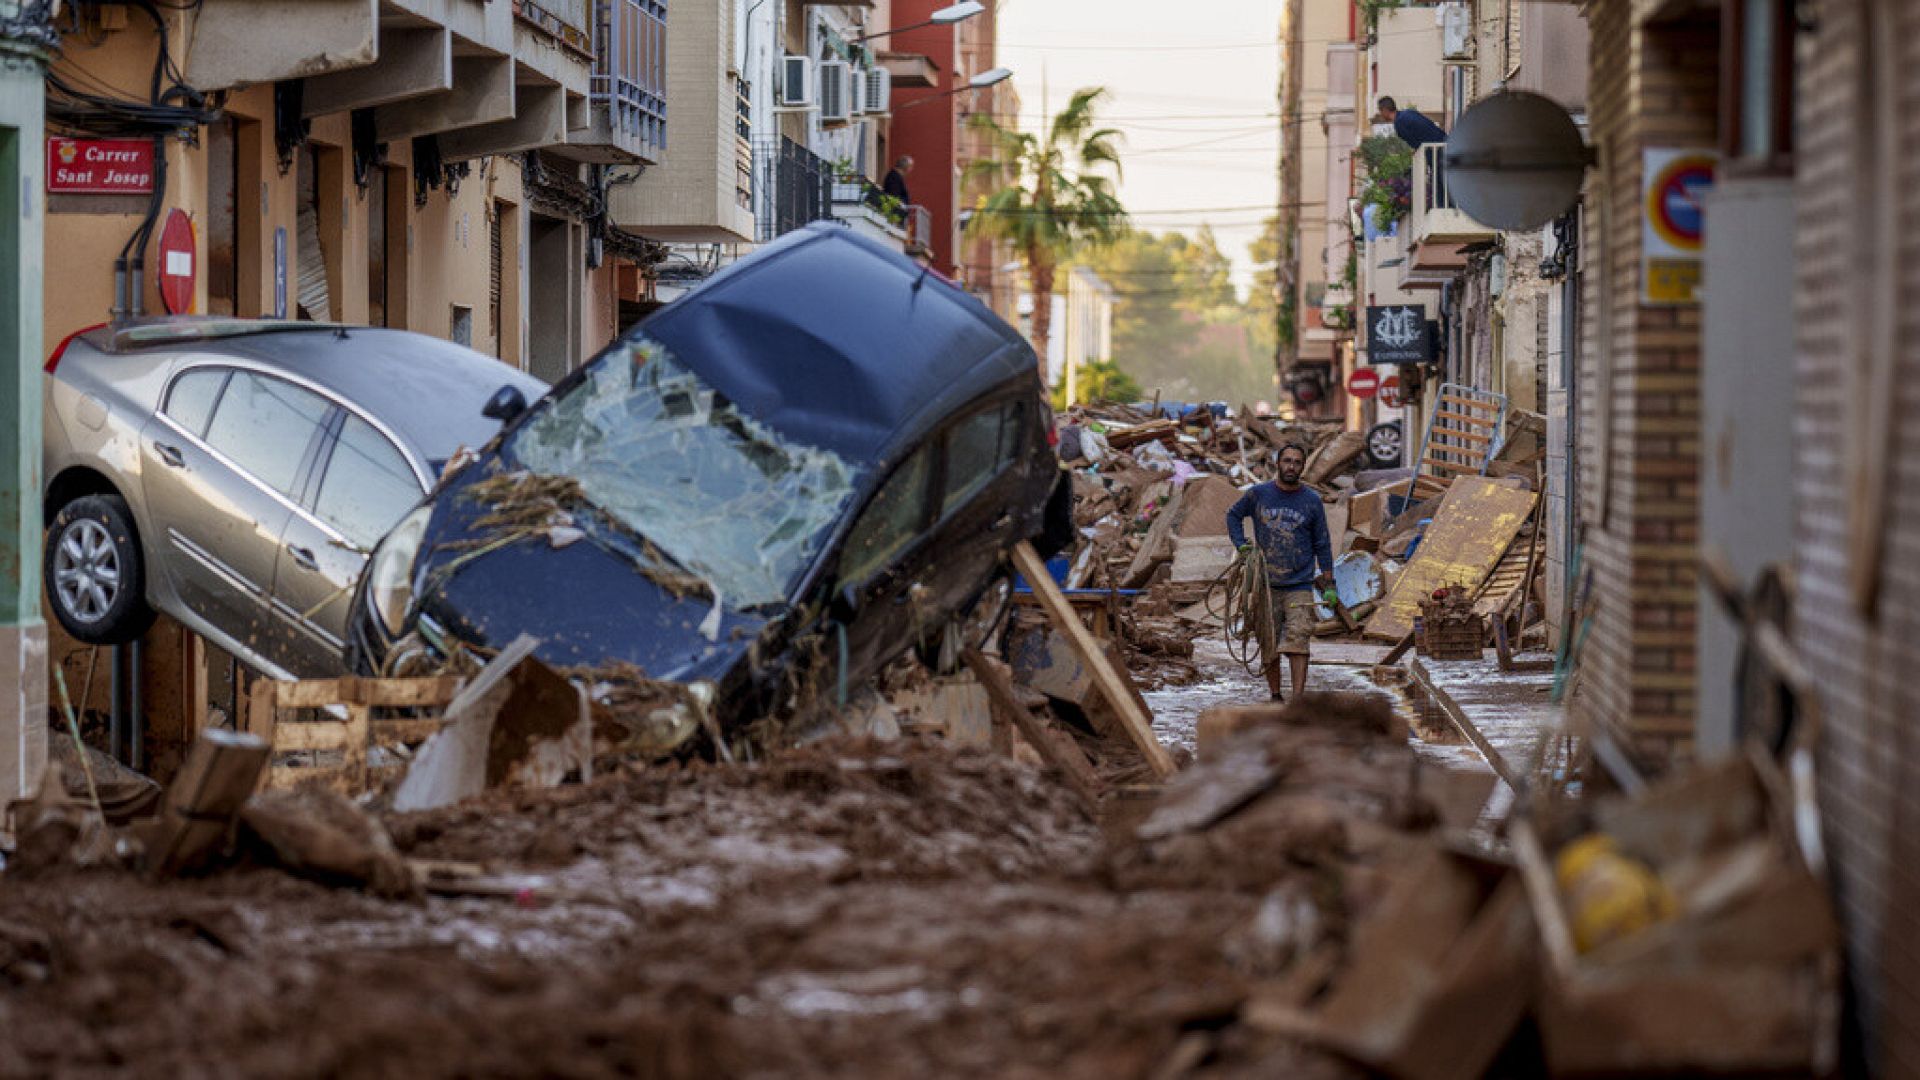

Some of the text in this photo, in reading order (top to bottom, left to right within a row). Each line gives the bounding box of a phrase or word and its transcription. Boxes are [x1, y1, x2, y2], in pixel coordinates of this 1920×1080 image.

[85, 146, 140, 162] Carrer
[57, 168, 149, 187] Sant Josep
